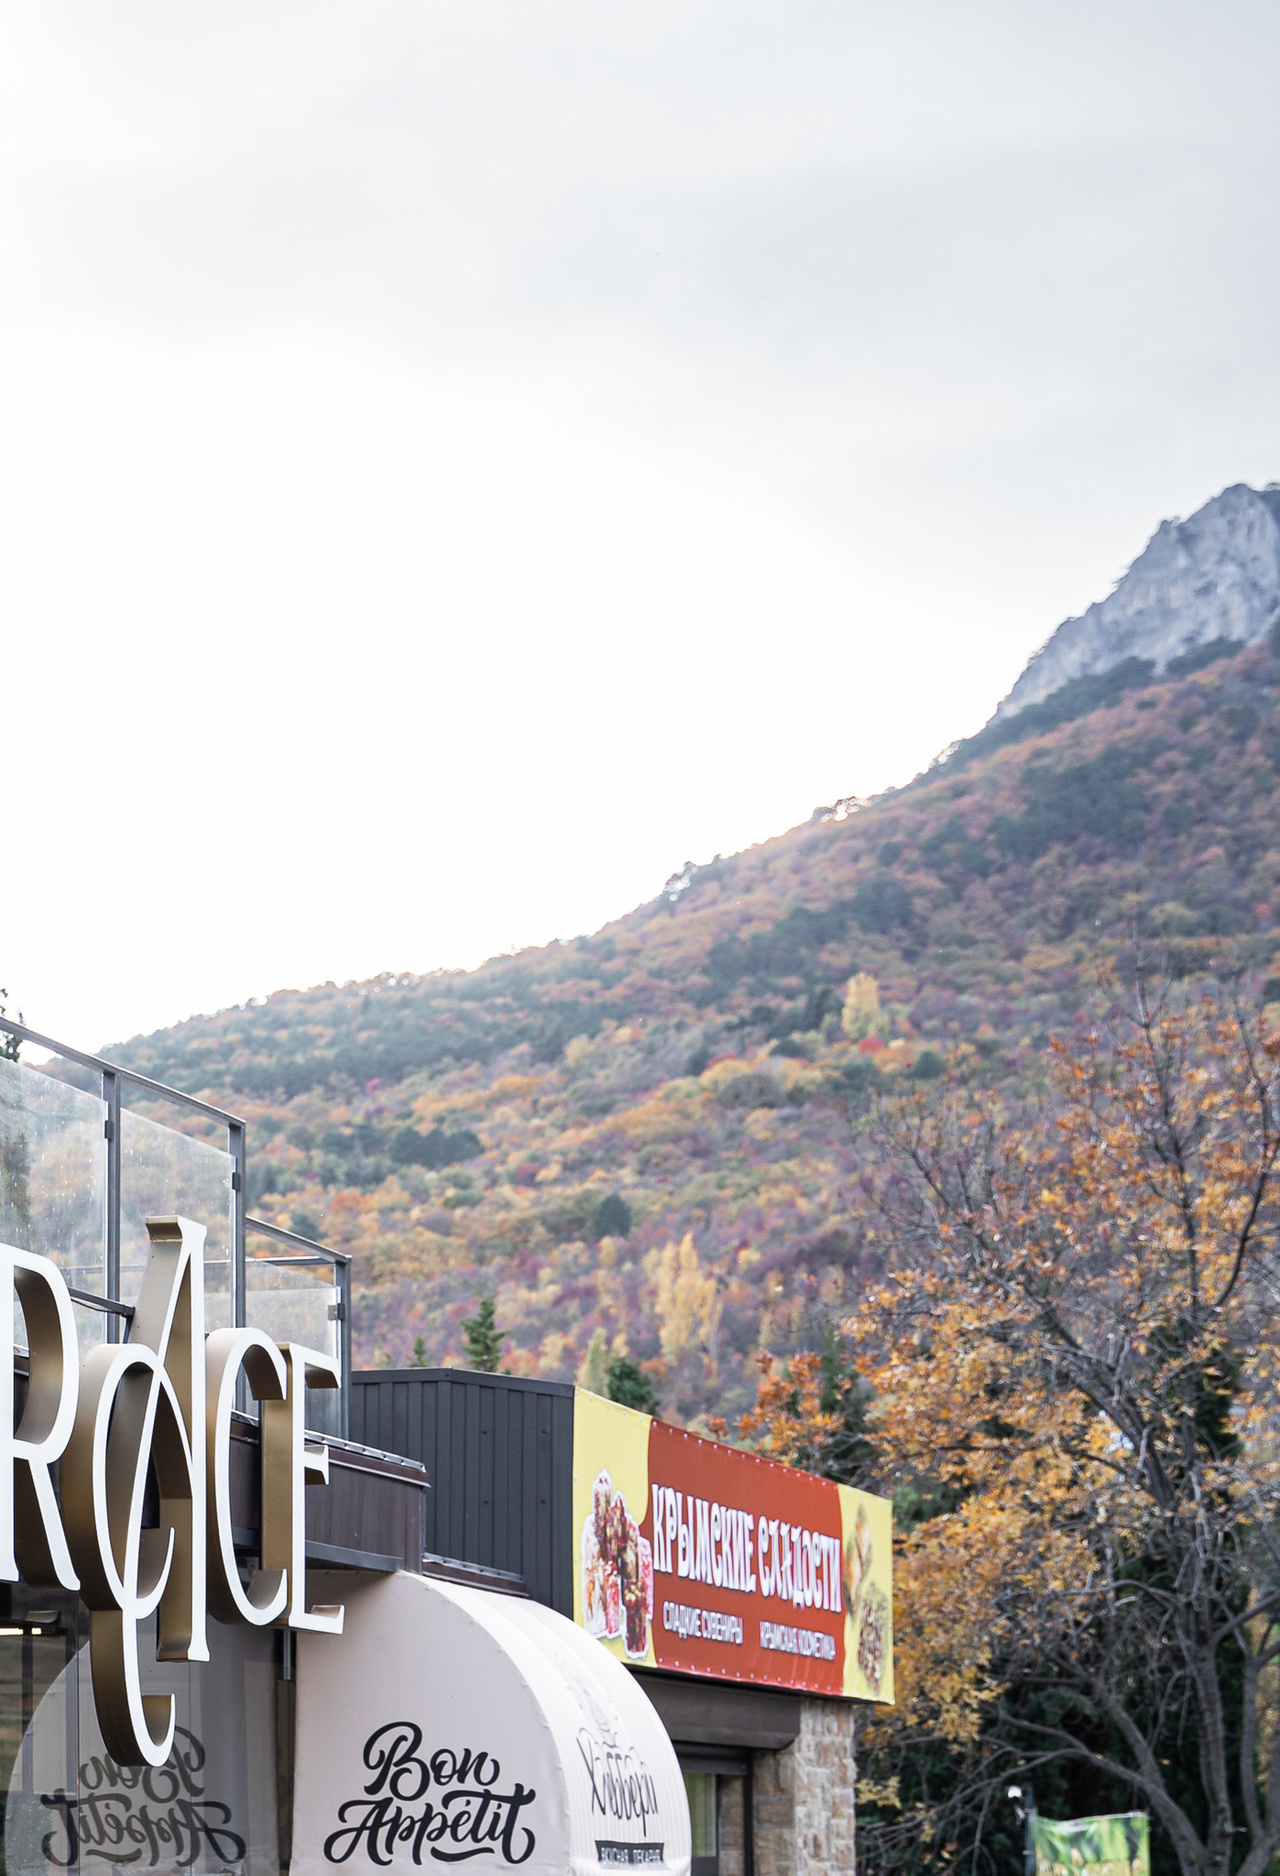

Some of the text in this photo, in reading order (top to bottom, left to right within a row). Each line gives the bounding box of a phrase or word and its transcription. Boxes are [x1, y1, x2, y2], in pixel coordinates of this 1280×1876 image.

[651, 1484, 842, 1613] КРЫМСКИЕ СЛАДОСТИ
[662, 1600, 744, 1645] СЛАДКИЕ СУВЕНИРЫ
[363, 1721, 500, 1801] Bon
[323, 1783, 536, 1867] Appétit
